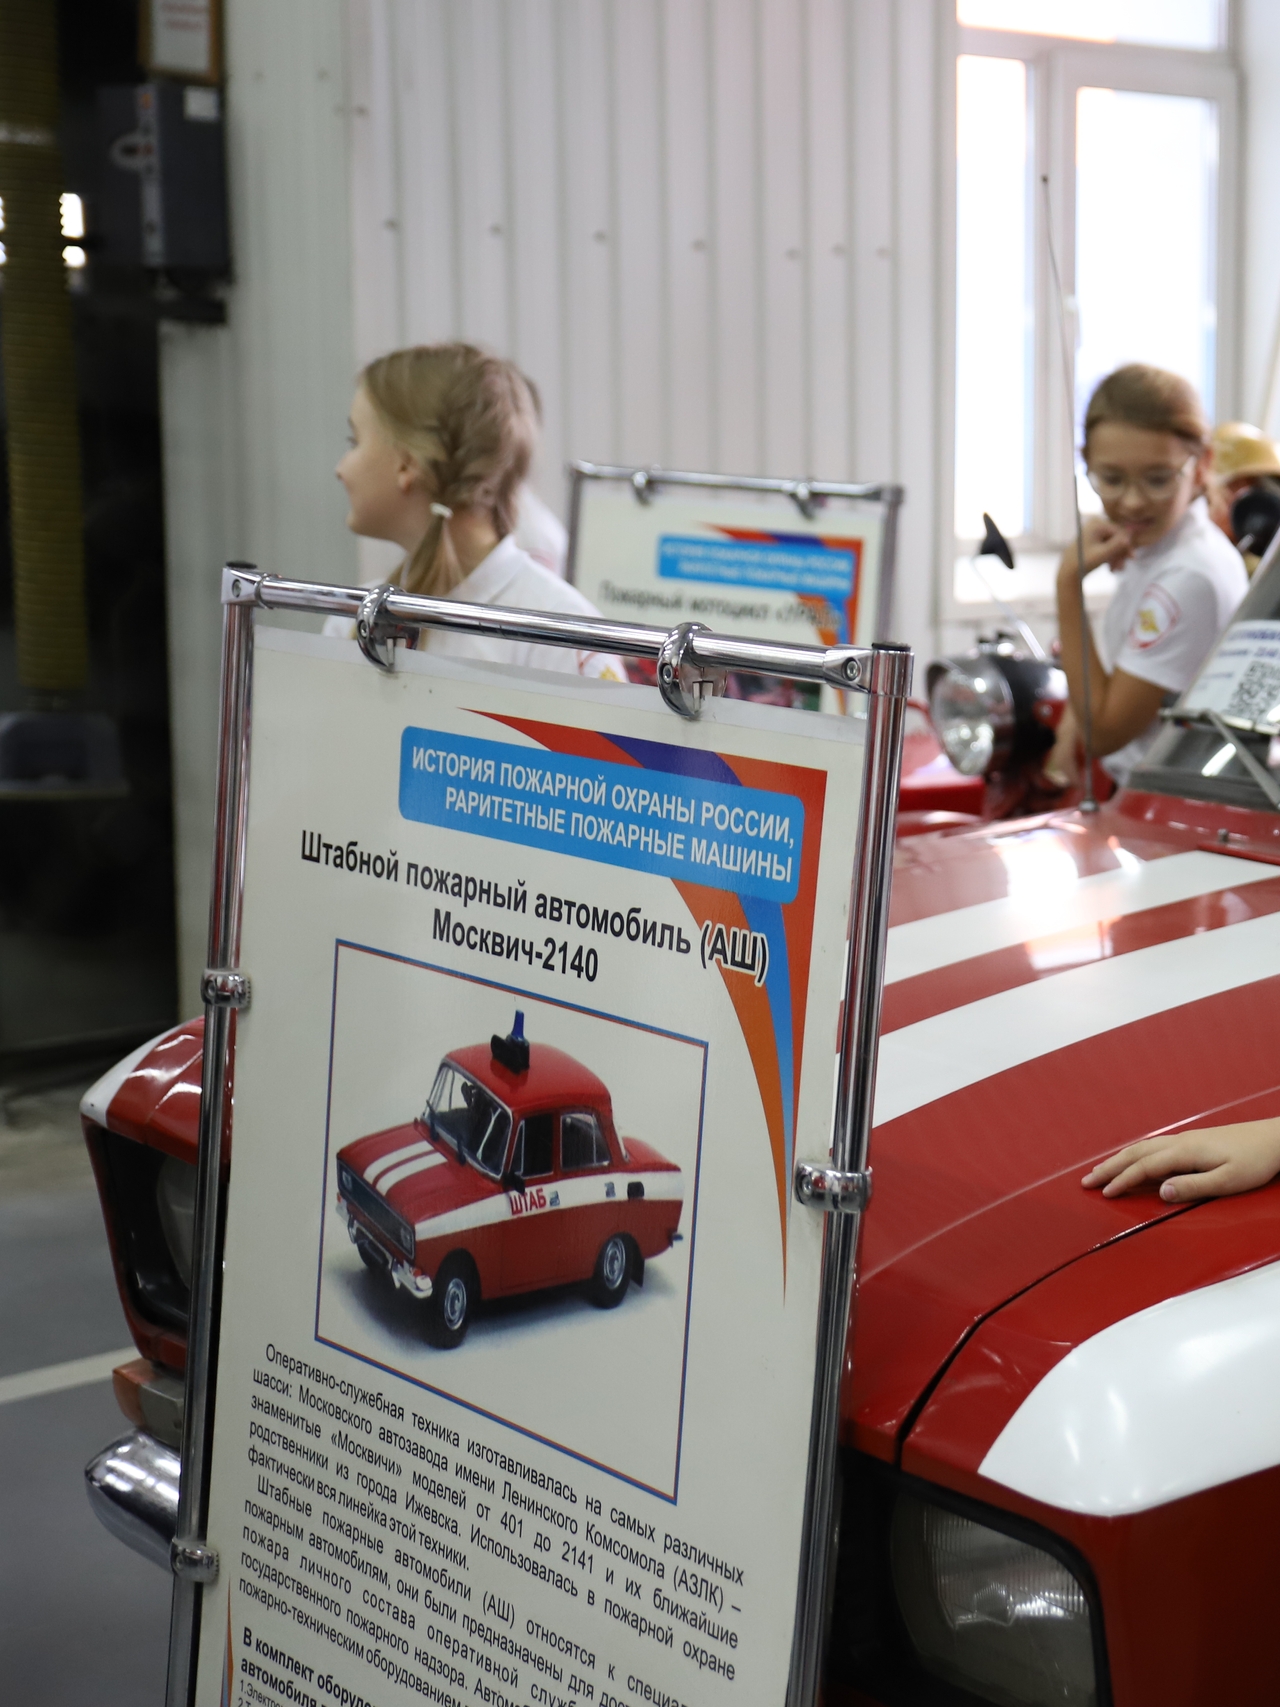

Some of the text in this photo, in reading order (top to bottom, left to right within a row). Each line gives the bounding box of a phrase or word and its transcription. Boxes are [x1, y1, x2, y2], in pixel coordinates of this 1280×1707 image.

[412, 746, 794, 849] ИСТОРИЯ ПОЖАРНОЙ ОХРАНЫ РОССИИ,
[445, 786, 792, 883] РАРИТЕТНЫЕ ПОЖАРНЫЕ МАШИНЫ
[300, 829, 768, 984] Штабной пожарный автомобиль (АШ)
[431, 907, 599, 983] Москвич-2140
[509, 1187, 547, 1216] ШТАБ
[247, 1443, 470, 1572] фактически вся линейка этой техники.
[250, 1394, 739, 1649] знаменитые «Москвичи» моделей от 401 до 2141 и их ближайшие
[252, 1367, 293, 1398] шасси:
[297, 1383, 373, 1435] Московского
[377, 1425, 449, 1472] автозавода
[454, 1461, 496, 1495] имени
[500, 1479, 578, 1535] Ленинского
[584, 1520, 665, 1580] Комсомола
[672, 1564, 724, 1614] (АЗЛК)
[265, 1342, 744, 1587] Оперативно-служебная техника изготавливалась на самых различных
[238, 1577, 365, 1660] пожарно-техническим
[240, 1551, 342, 1617] государственного
[345, 1607, 409, 1656] пожарного
[413, 1645, 468, 1691] надзора.
[241, 1524, 577, 1707] пожара личного состава оперативной служ
[243, 1498, 304, 1542] пожарным
[307, 1531, 391, 1591] автомобилям,
[395, 1578, 419, 1603] они
[423, 1588, 457, 1624] были
[461, 1613, 563, 1683] предназначены
[566, 1673, 595, 1701] для
[248, 1420, 736, 1681] родственники из города Ижевска. Использовалась в пожарной охране
[256, 1473, 313, 1518] Штабные
[321, 1510, 384, 1555] пожарные
[393, 1548, 472, 1602] автомобили
[481, 1590, 515, 1630] (АШ)
[525, 1618, 596, 1670] относятся
[607, 1662, 616, 1681] к
[242, 1625, 377, 1707] В комплект оборуд
